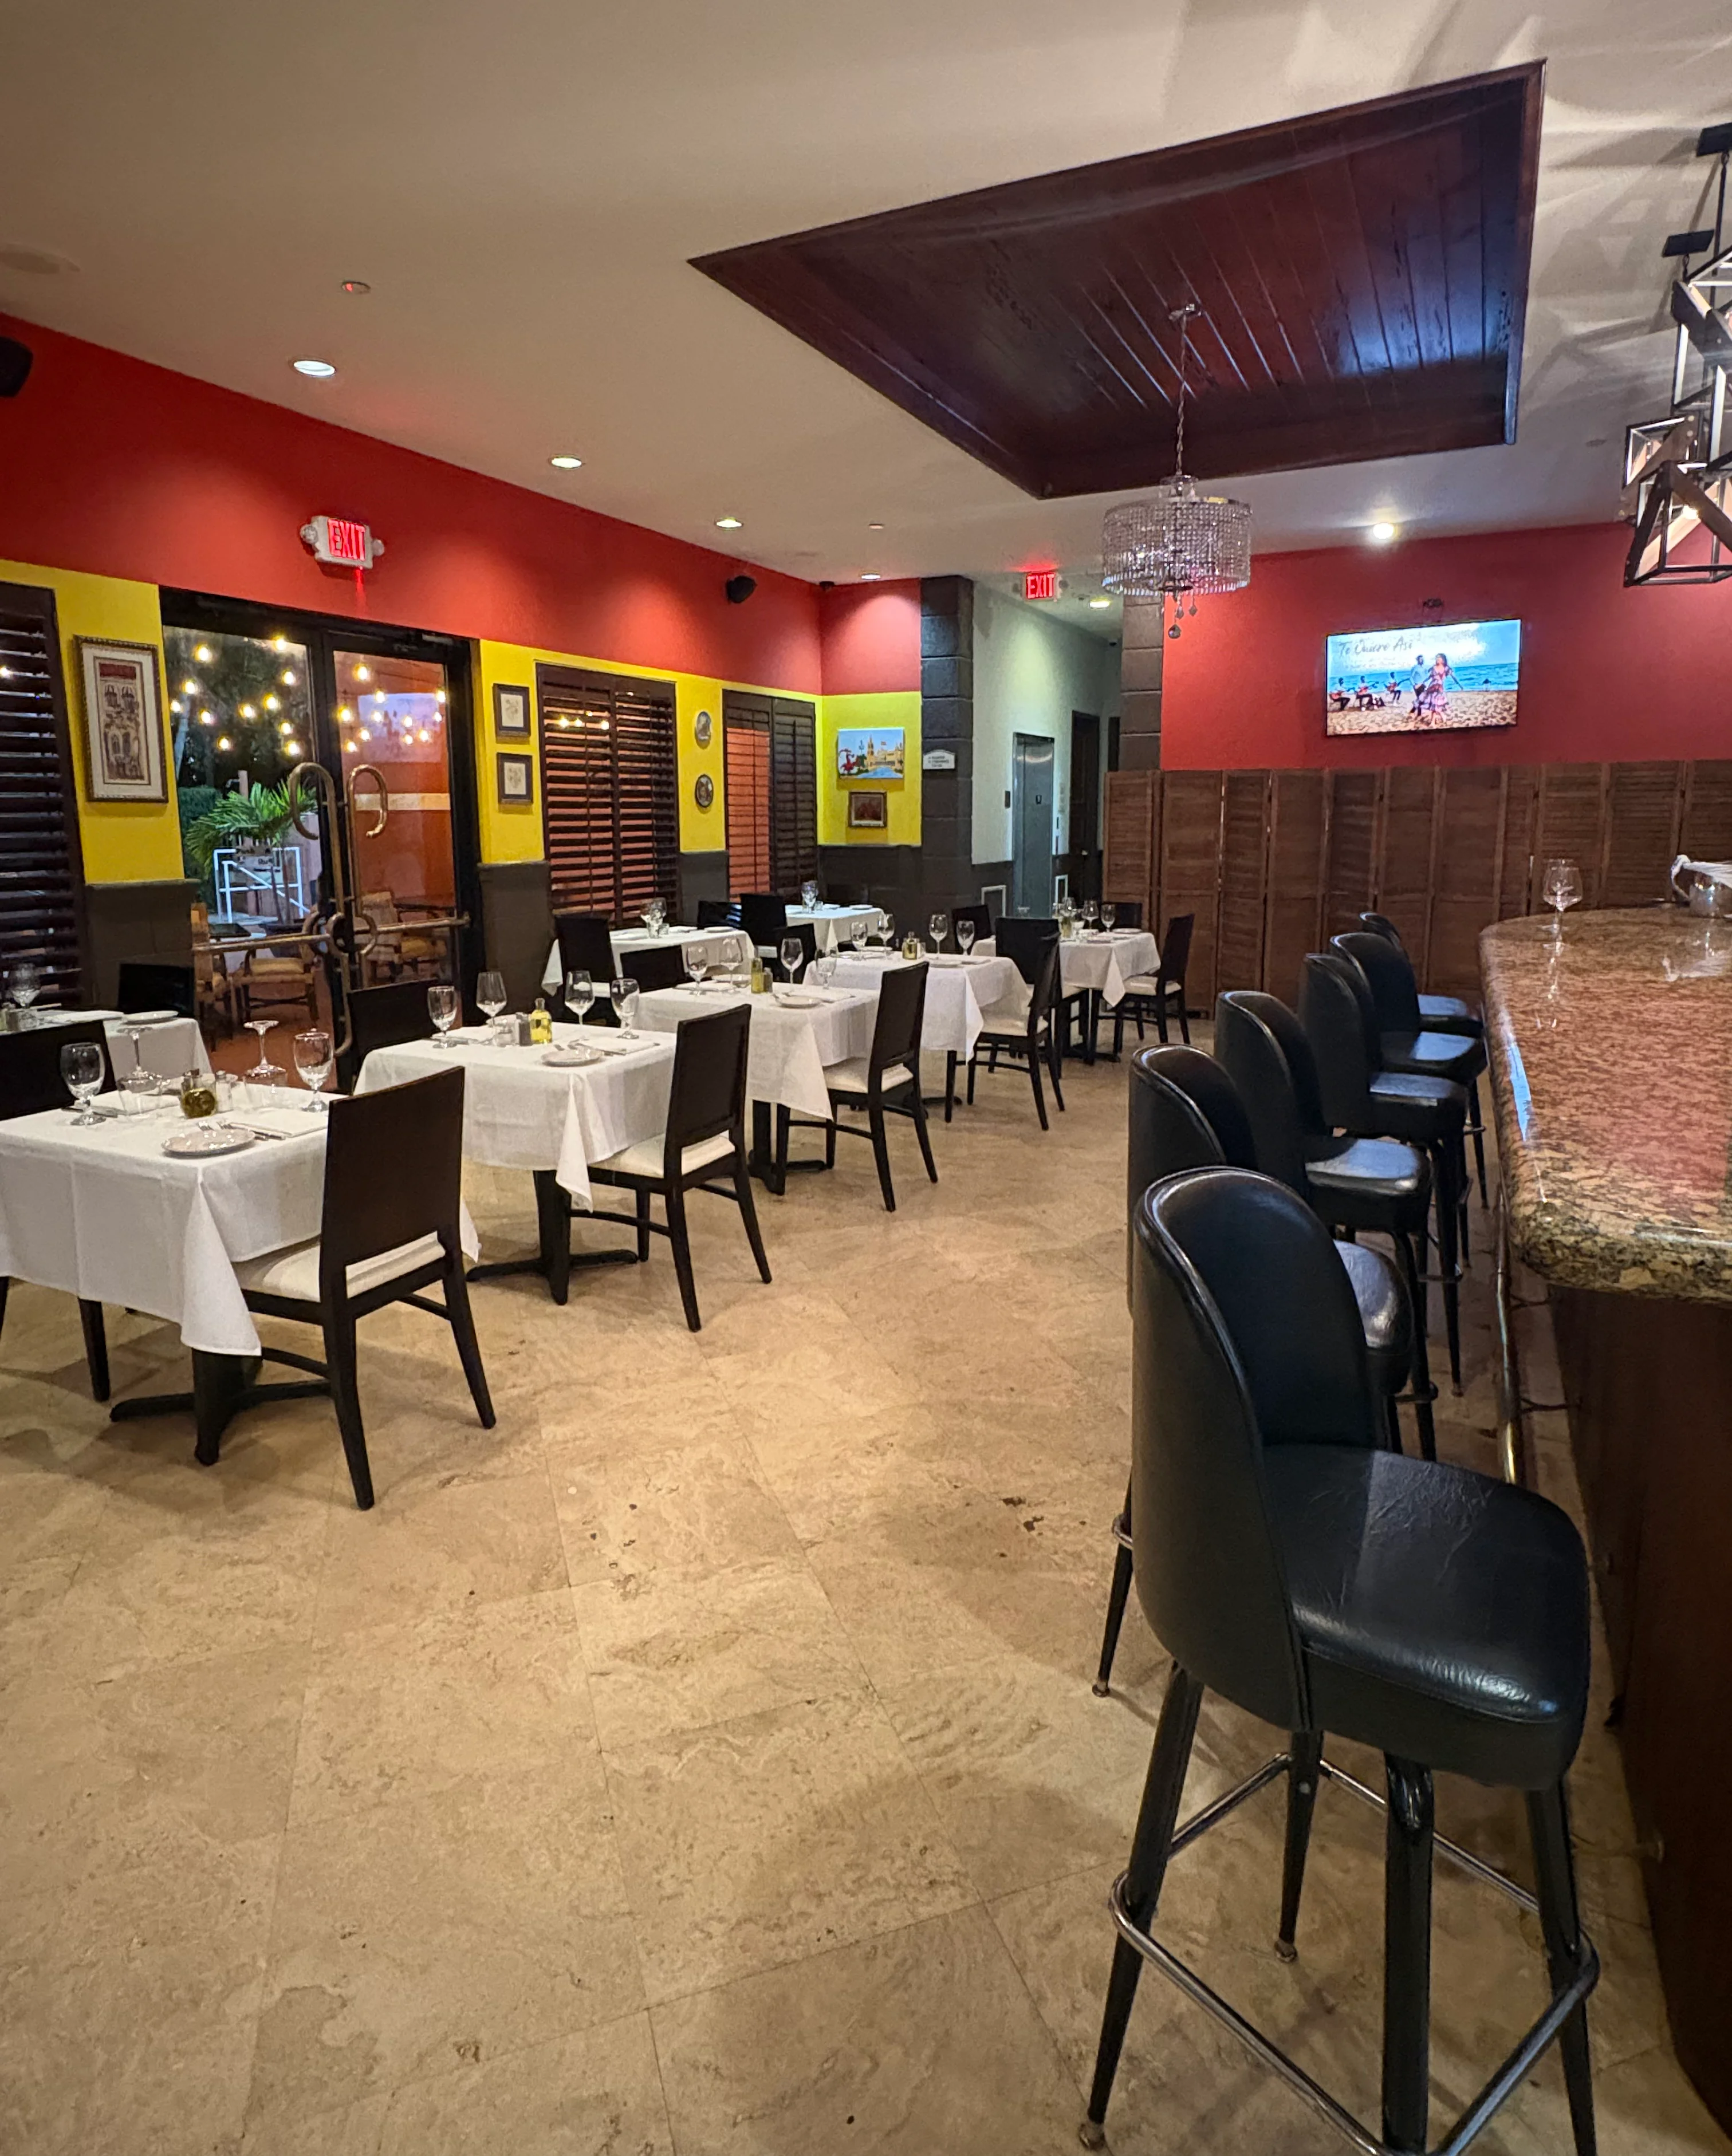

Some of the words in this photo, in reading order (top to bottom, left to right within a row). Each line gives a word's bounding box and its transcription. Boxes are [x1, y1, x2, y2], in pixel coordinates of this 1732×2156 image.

[328, 519, 365, 561] EXIT
[1027, 574, 1055, 599] EXIT
[1339, 641, 1352, 657] Te
